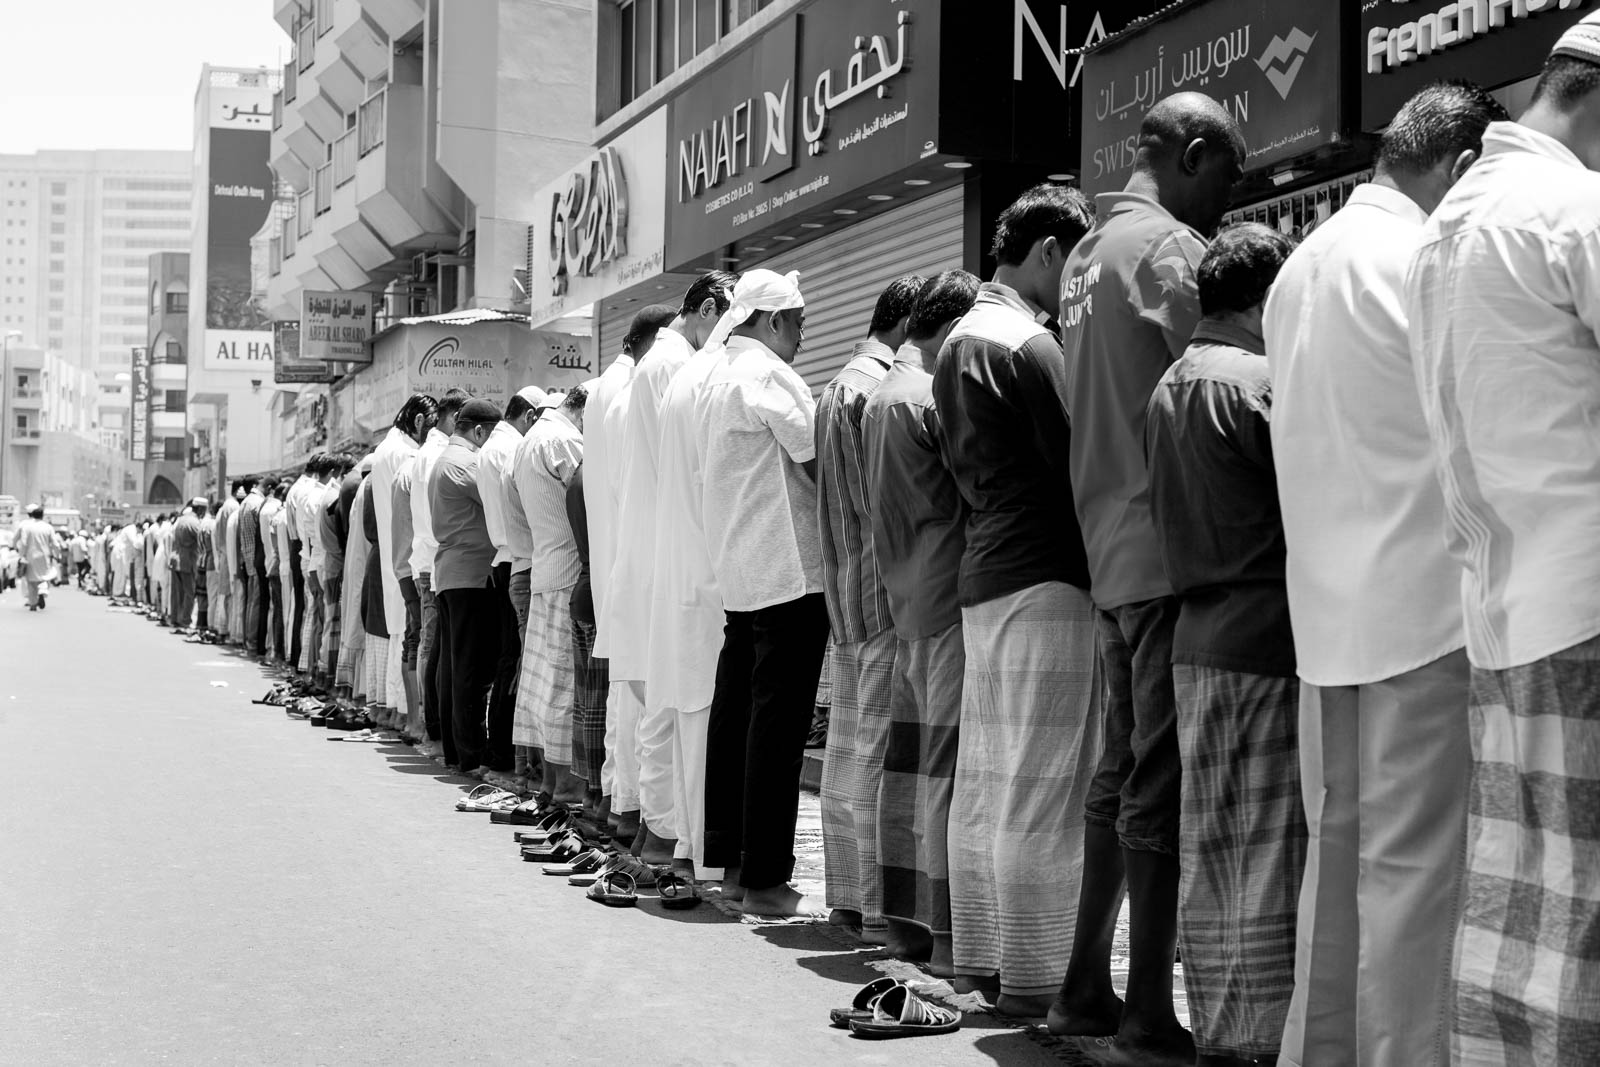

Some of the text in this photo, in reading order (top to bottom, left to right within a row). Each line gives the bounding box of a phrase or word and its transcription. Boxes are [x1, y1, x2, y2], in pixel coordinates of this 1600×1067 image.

[1013, 0, 1107, 90] NA
[1171, 25, 1251, 88] سويس
[679, 98, 753, 203] NAJAFI
[705, 192, 731, 215] COSMETICS
[308, 325, 330, 341] ABEER
[333, 326, 342, 342] AL
[217, 341, 273, 360] AL HA
[433, 358, 494, 369] SULTAN HILAL
